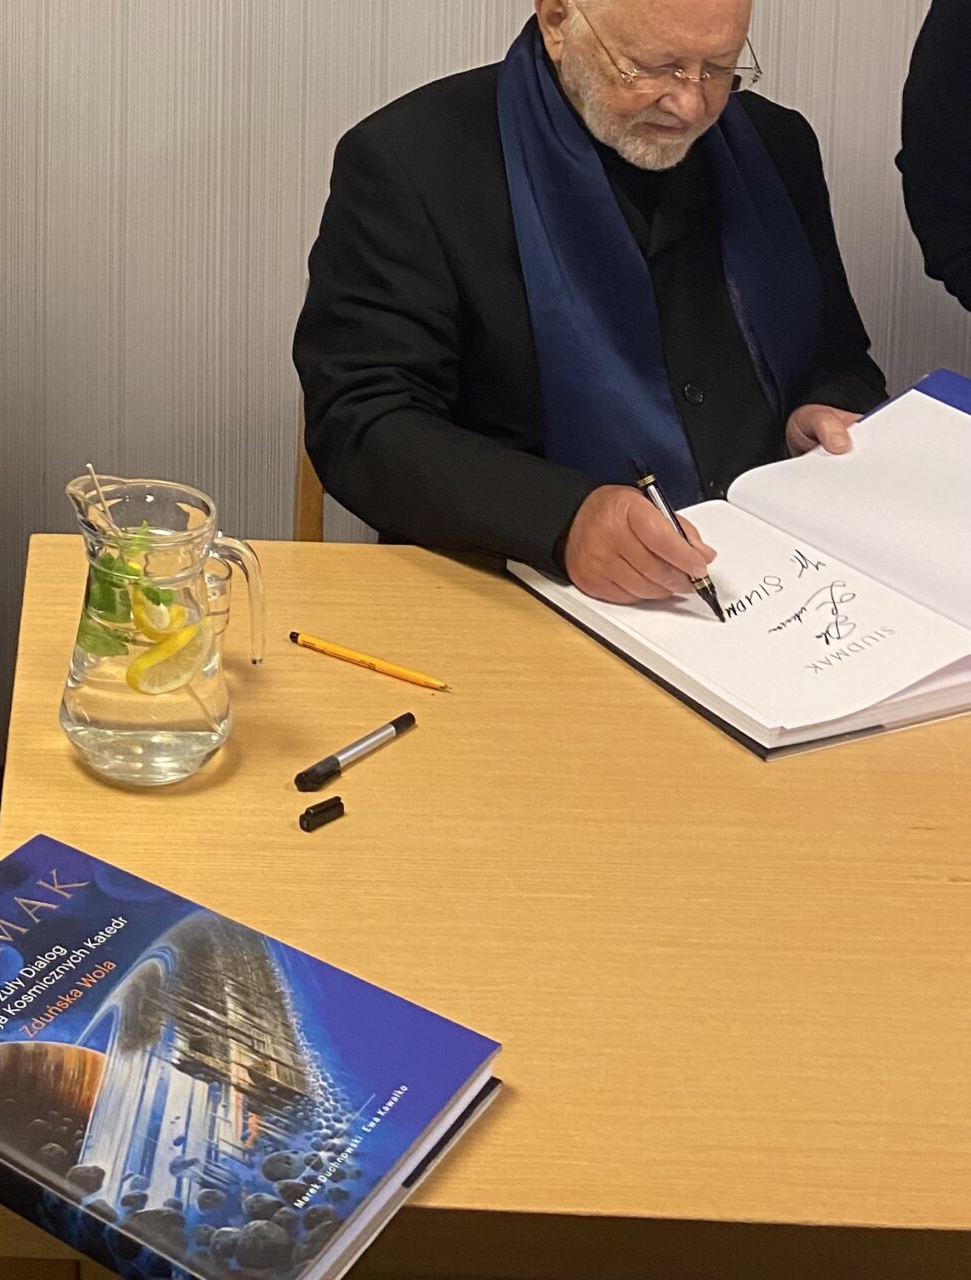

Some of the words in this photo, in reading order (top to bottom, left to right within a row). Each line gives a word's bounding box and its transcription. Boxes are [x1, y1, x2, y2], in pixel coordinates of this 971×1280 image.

[804, 625, 896, 674] SIUDMAK
[6, 947, 90, 1023] Kosmicznych
[83, 915, 129, 952] Katedr
[19, 943, 67, 980] Dialog
[19, 988, 82, 1038] Zduńska
[77, 959, 116, 992] Wola
[293, 1182, 322, 1209] Marek
[361, 1116, 381, 1133] Ewa
